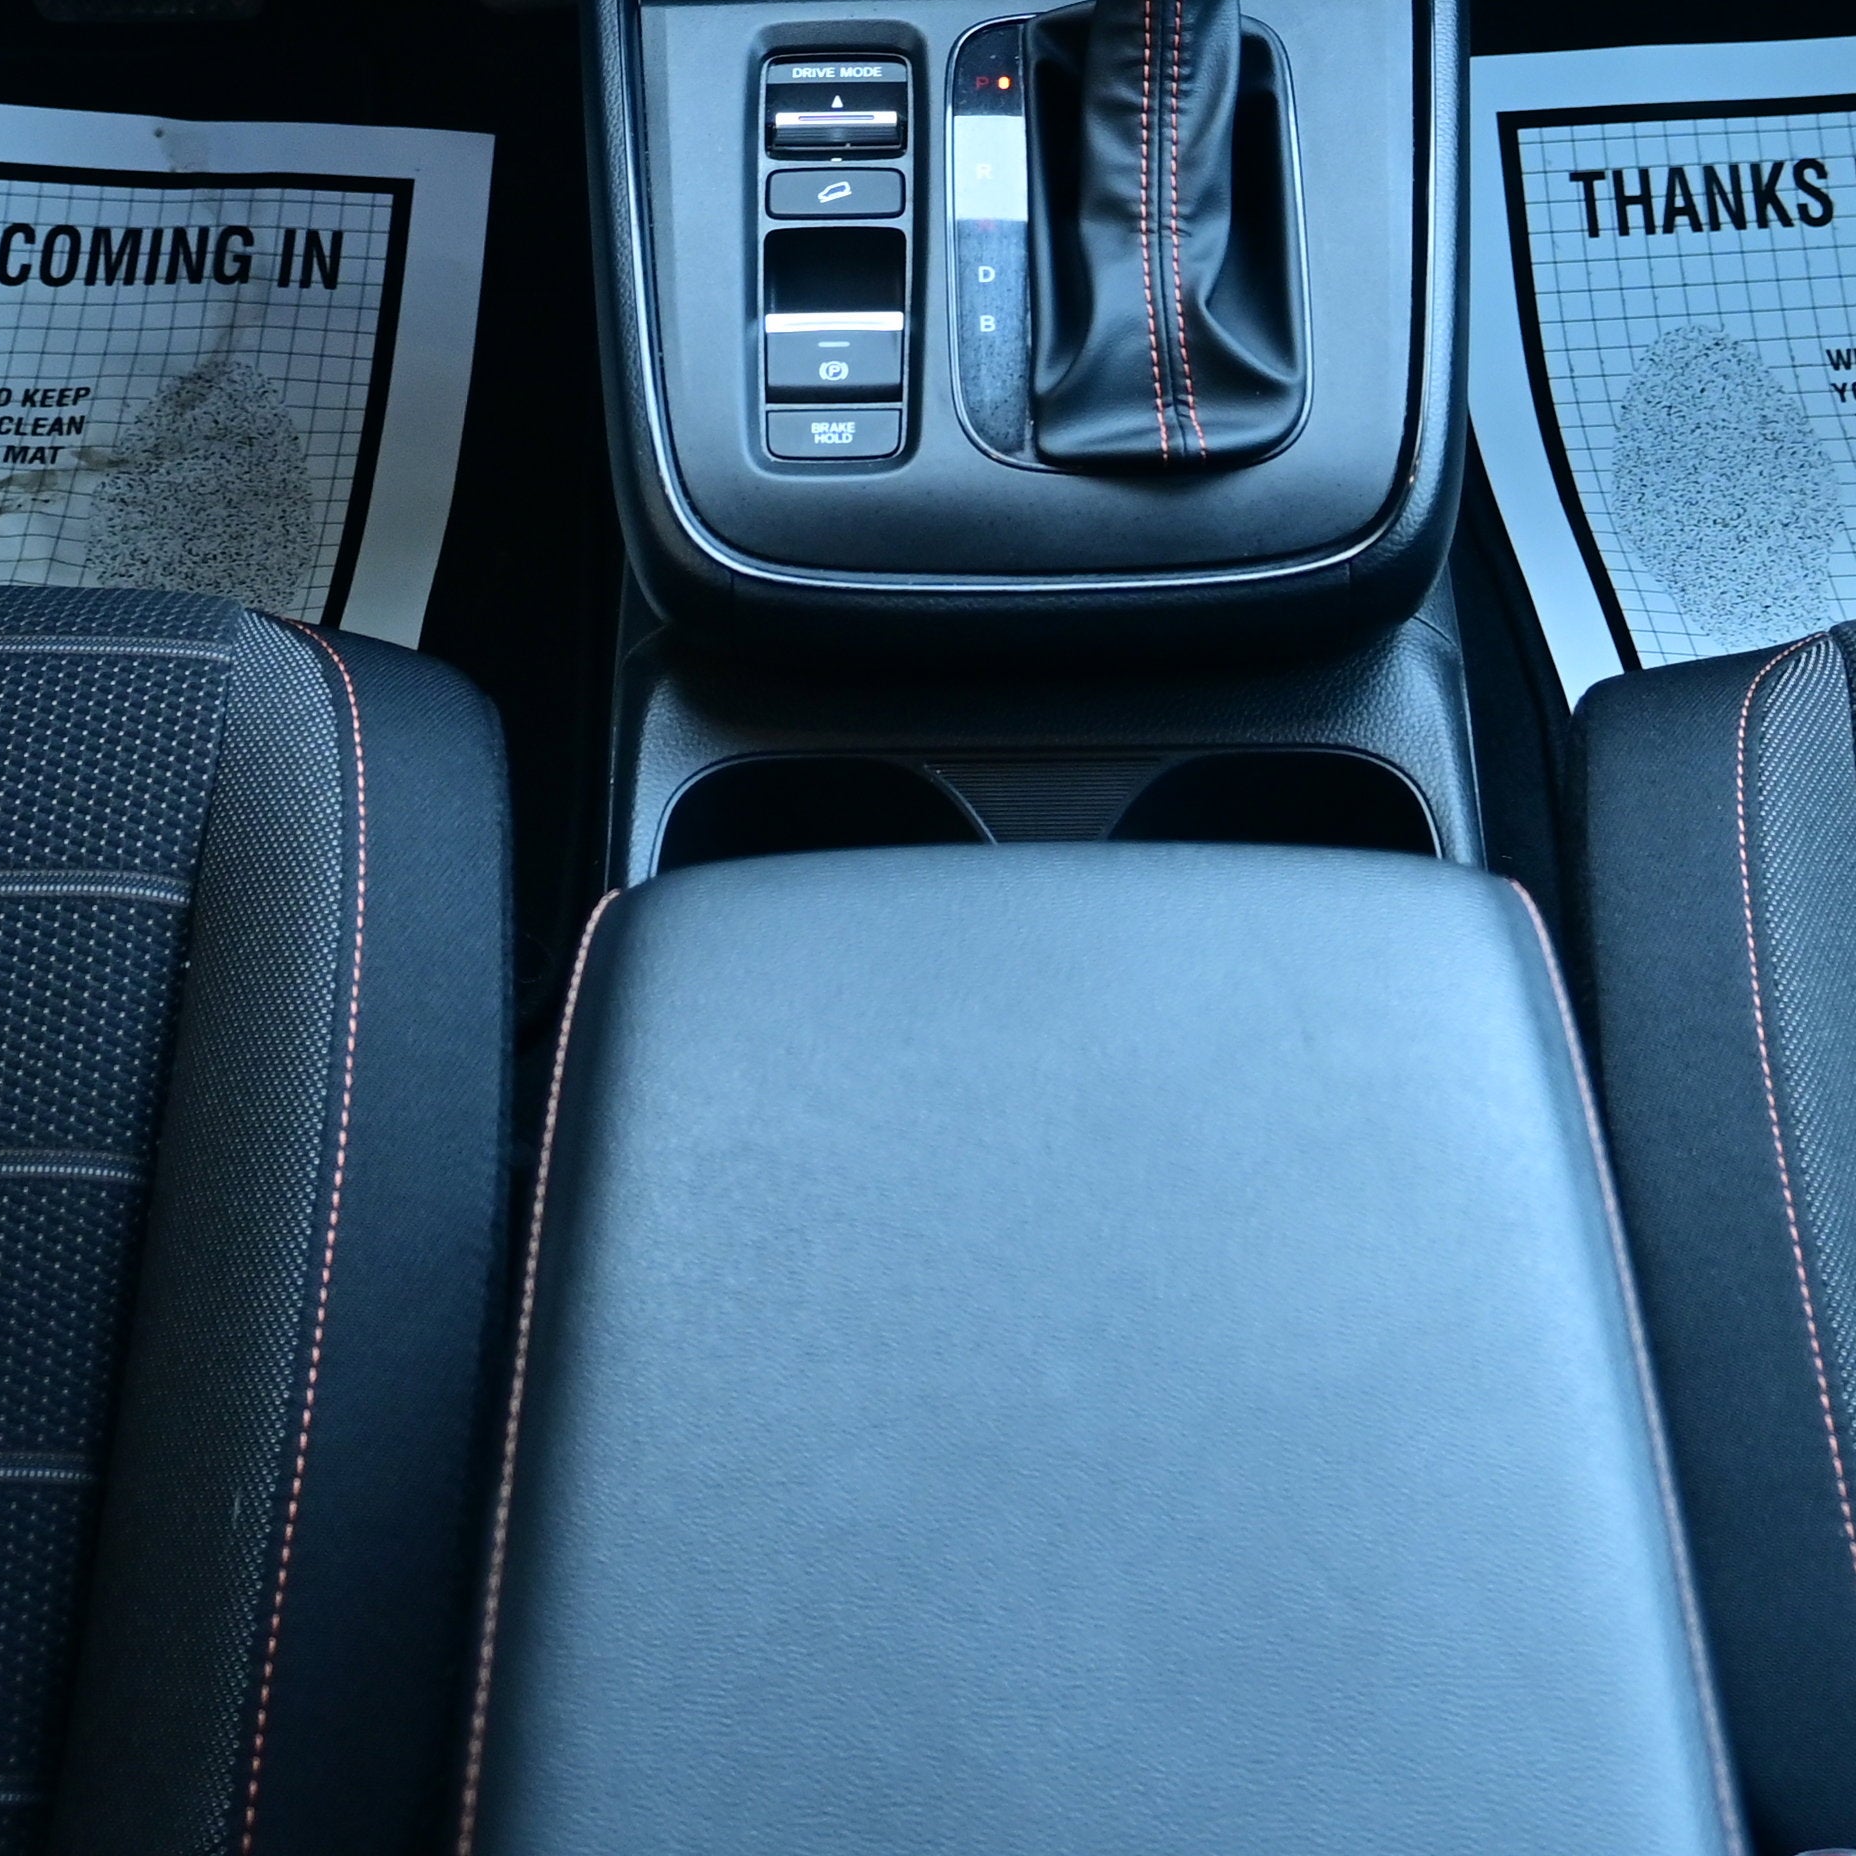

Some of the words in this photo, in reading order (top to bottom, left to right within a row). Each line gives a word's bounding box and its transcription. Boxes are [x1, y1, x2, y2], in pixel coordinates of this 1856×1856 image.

[791, 66, 836, 79] DRIVE
[839, 66, 883, 78] MODE
[975, 76, 990, 90] P
[1568, 158, 1834, 238] THANKS
[276, 228, 344, 290] IN
[978, 266, 996, 283] D
[979, 315, 996, 332] B
[20, 387, 91, 408] KEEP
[811, 421, 856, 434] BRAKE
[813, 432, 854, 445] HOLD
[2, 445, 65, 465] MAT
